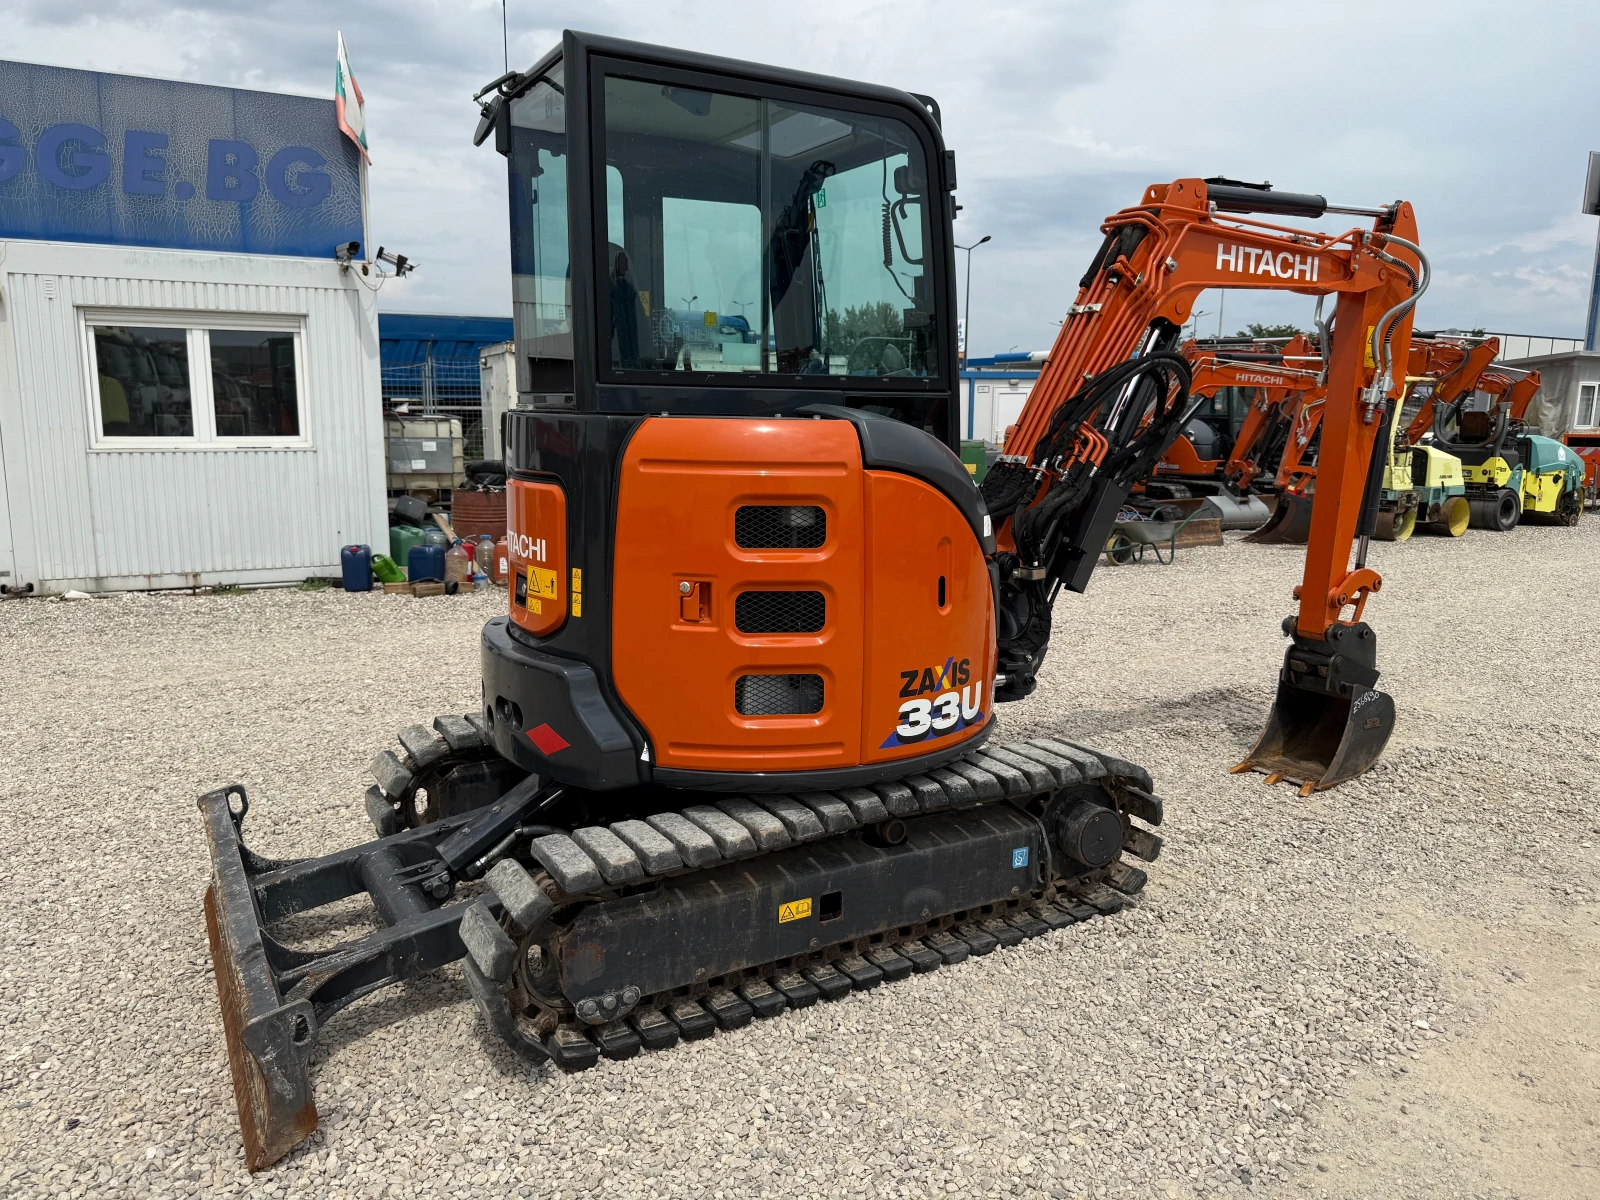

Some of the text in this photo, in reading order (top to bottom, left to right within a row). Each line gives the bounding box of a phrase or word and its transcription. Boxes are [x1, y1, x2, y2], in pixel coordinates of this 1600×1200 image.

[1216, 242, 1320, 282] HITACHI
[1235, 372, 1284, 385] HITACHI
[898, 656, 970, 698] ZAXIS
[895, 680, 982, 744] 33U
